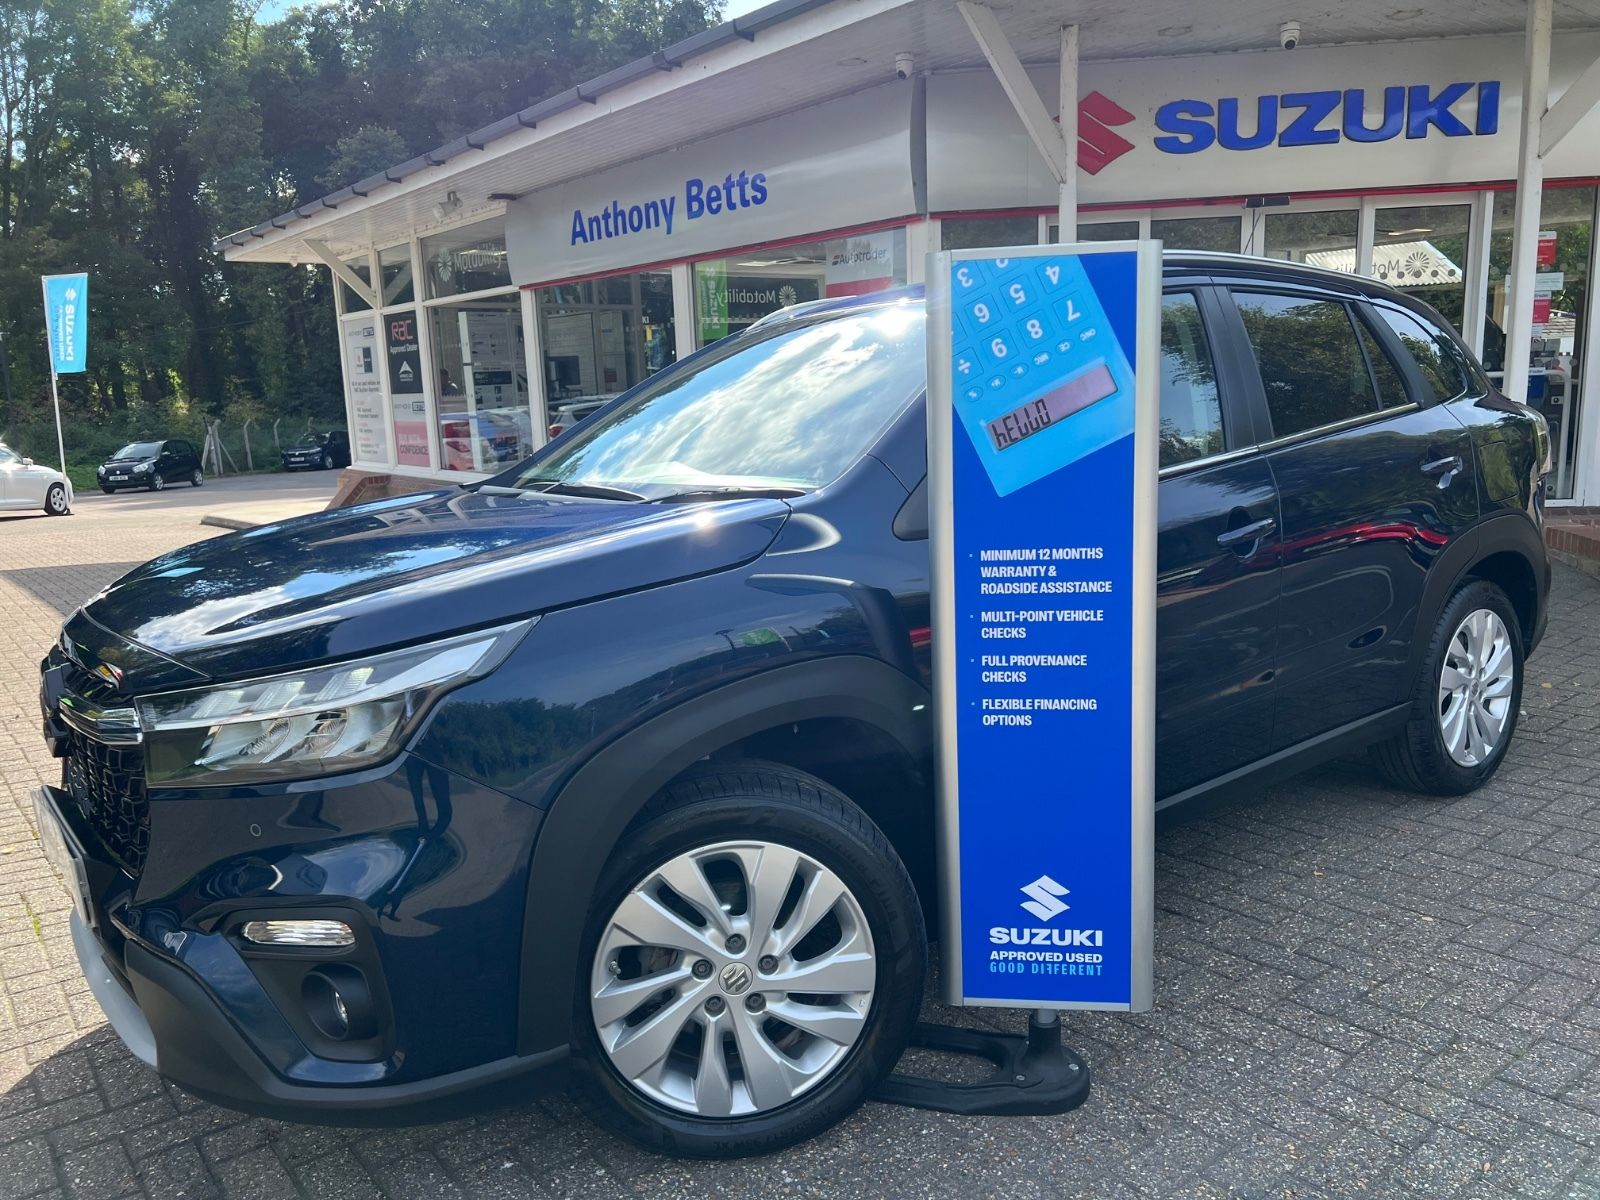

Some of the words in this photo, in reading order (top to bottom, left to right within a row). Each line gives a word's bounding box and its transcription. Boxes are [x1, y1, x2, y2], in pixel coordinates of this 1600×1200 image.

[1153, 80, 1501, 154] SUZUKI
[571, 197, 675, 246] Anthony
[686, 170, 768, 220] Betts
[840, 248, 887, 265] Autotrader
[1046, 265, 1060, 284] 4
[1009, 284, 1026, 304] 5
[1066, 300, 1080, 321] 7
[65, 304, 74, 361] SUZUKI
[1026, 319, 1043, 339] 8
[980, 549, 1037, 561] MINIMUM
[1037, 548, 1051, 560] 12
[1052, 547, 1104, 560] MONTHS
[980, 565, 1047, 578] WARRANTY
[1047, 565, 1057, 577] &
[980, 582, 1038, 594] ROADSIDE
[1039, 581, 1113, 594] ASSISTANCE
[981, 610, 1055, 622] MULTI-POINT
[1055, 609, 1104, 621] VEHICLE
[981, 627, 1027, 639] CHECKS
[981, 655, 1009, 667] FULL
[1009, 654, 1087, 666] PROVENANCE
[981, 671, 1027, 683] CHECKS
[982, 699, 1033, 710] FLEXIBLE
[1034, 698, 1098, 710] FINANCING
[982, 714, 1032, 726] OPTIONS
[989, 926, 1103, 947] SUZUKI
[990, 950, 1063, 962] APPROVED
[1065, 952, 1103, 963] USED
[989, 961, 1025, 973] GOOD
[1031, 963, 1103, 976] DIFFERENT
